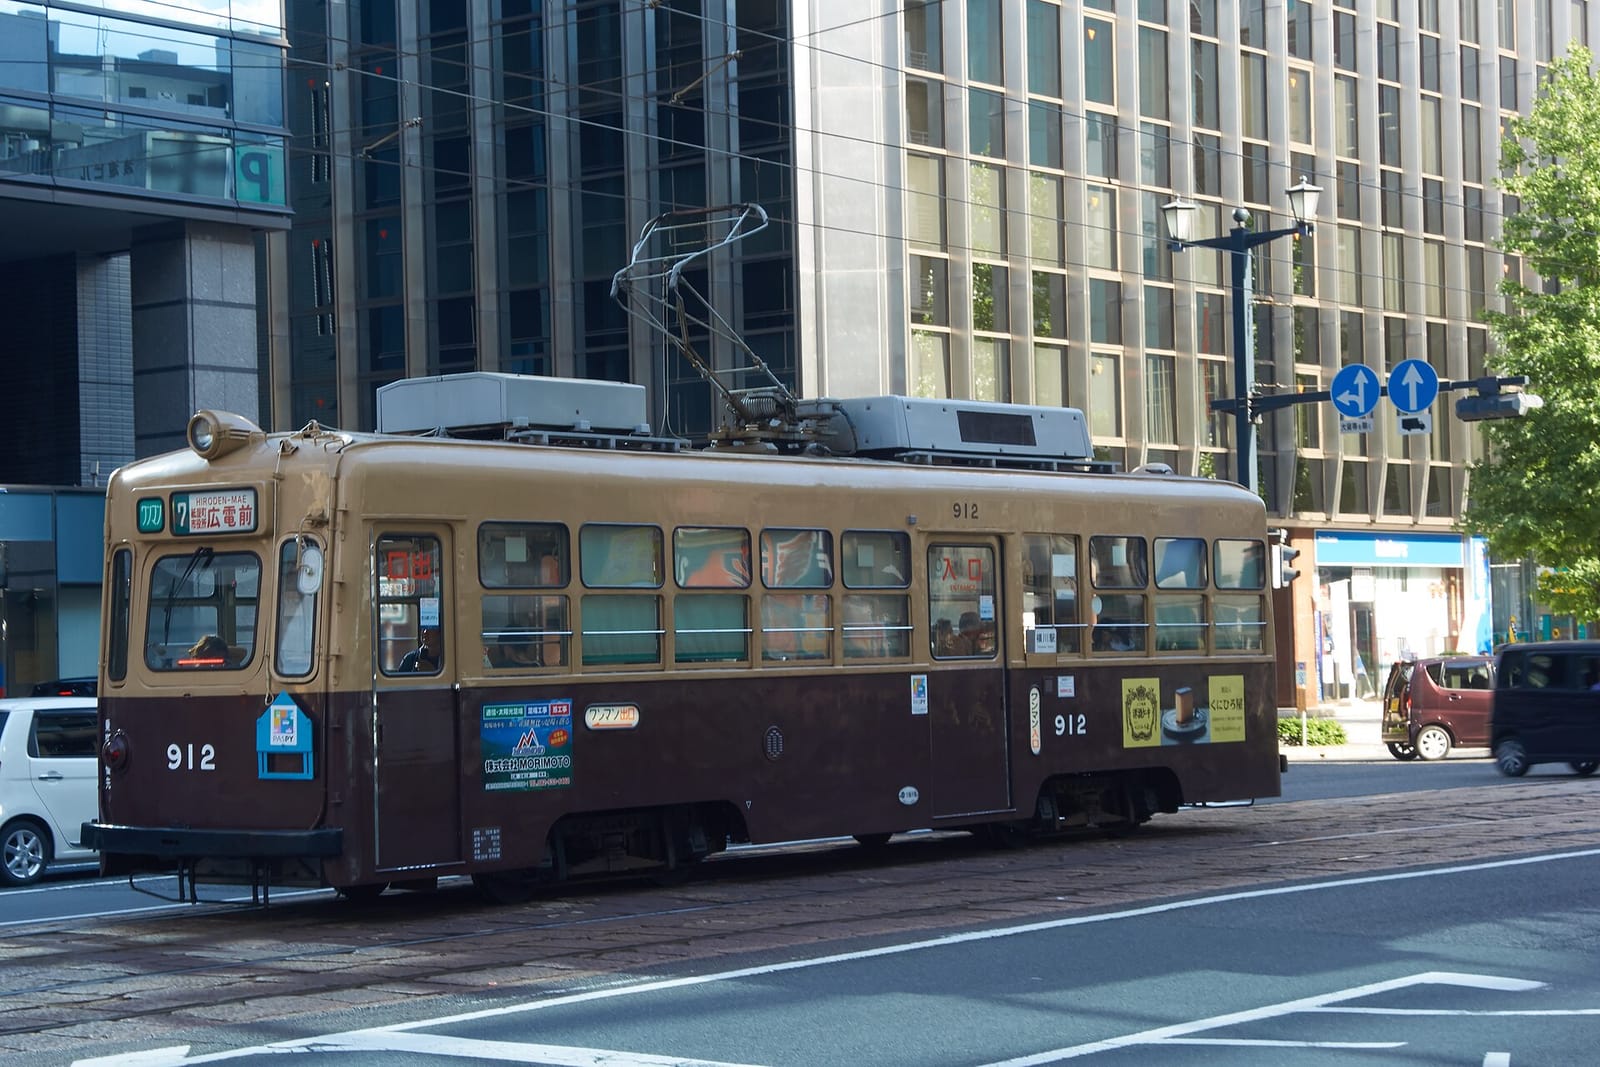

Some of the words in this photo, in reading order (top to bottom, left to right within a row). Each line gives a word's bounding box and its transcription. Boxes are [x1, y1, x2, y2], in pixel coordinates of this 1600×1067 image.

[196, 494, 247, 506] HIRODEN-MAE
[953, 503, 979, 520] 912
[177, 502, 187, 527] 7
[207, 504, 253, 528] 広電前
[942, 556, 982, 582] 入口
[589, 707, 635, 722] ワンマン出口
[1054, 713, 1087, 736] 912
[166, 742, 216, 771] 912
[519, 755, 571, 771] MORIMOTO
